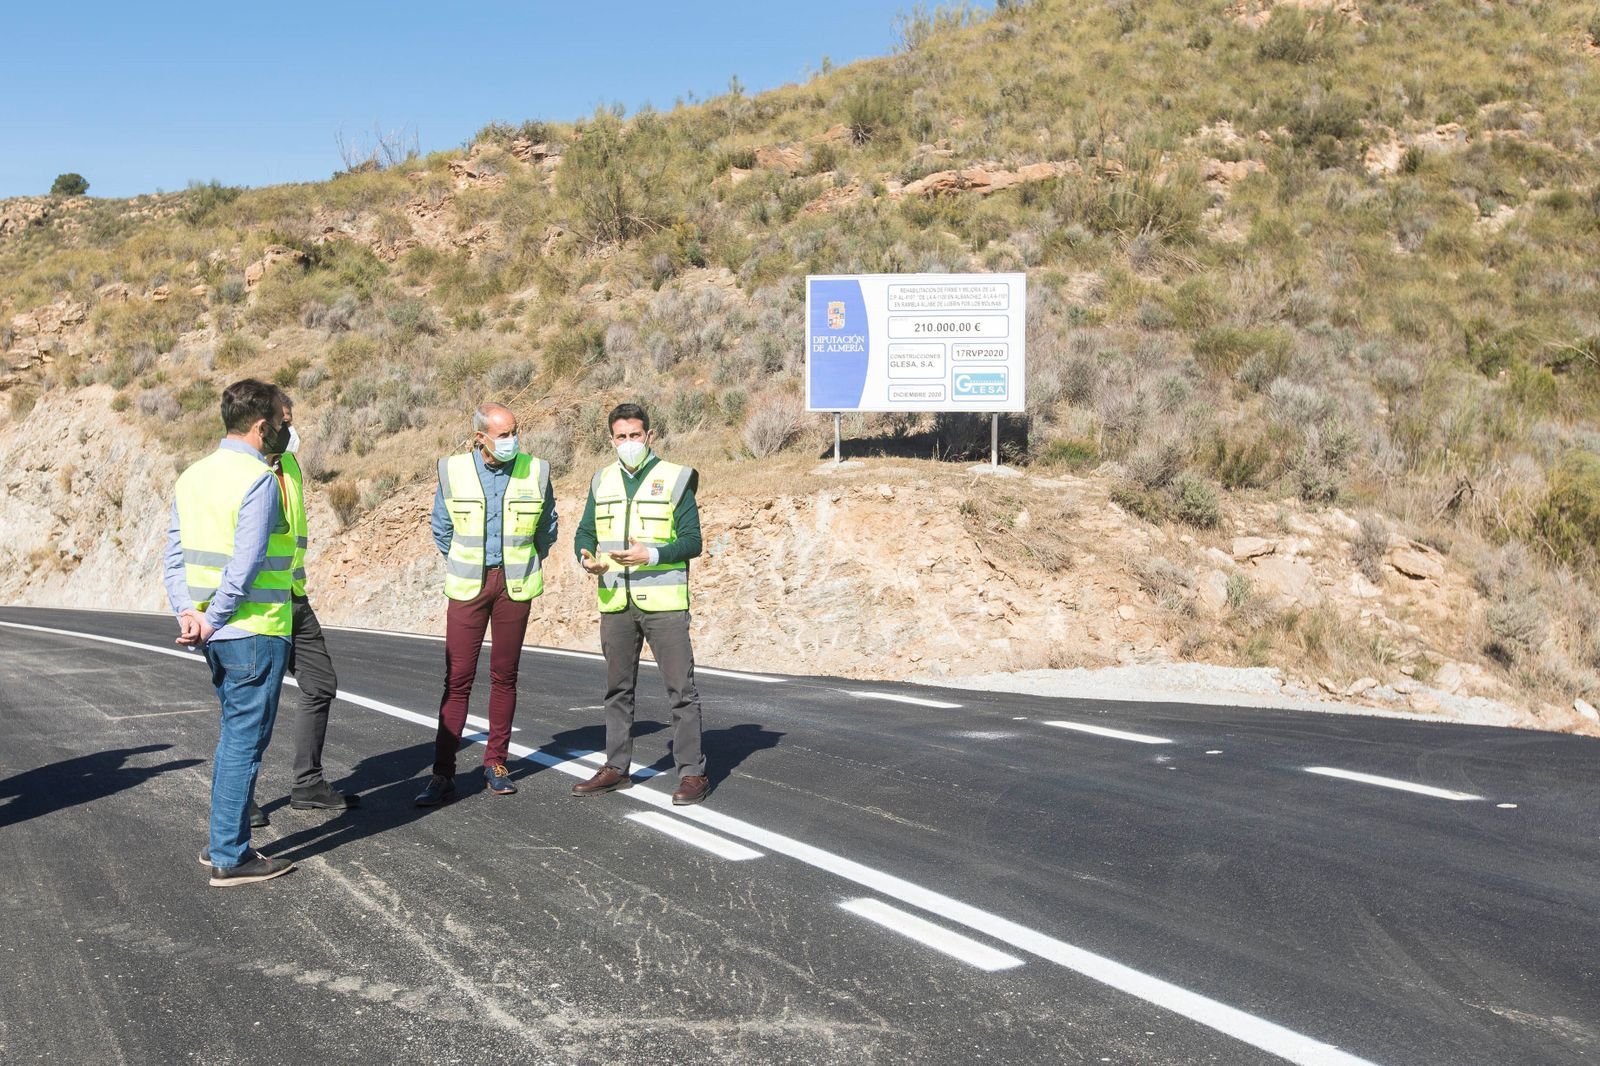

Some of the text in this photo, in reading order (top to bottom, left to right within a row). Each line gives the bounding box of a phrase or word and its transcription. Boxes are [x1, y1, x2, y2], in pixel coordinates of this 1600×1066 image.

[974, 322, 981, 332] €
[812, 334, 865, 344] DIPUTACIÓN
[827, 343, 864, 352] ALMERÍA
